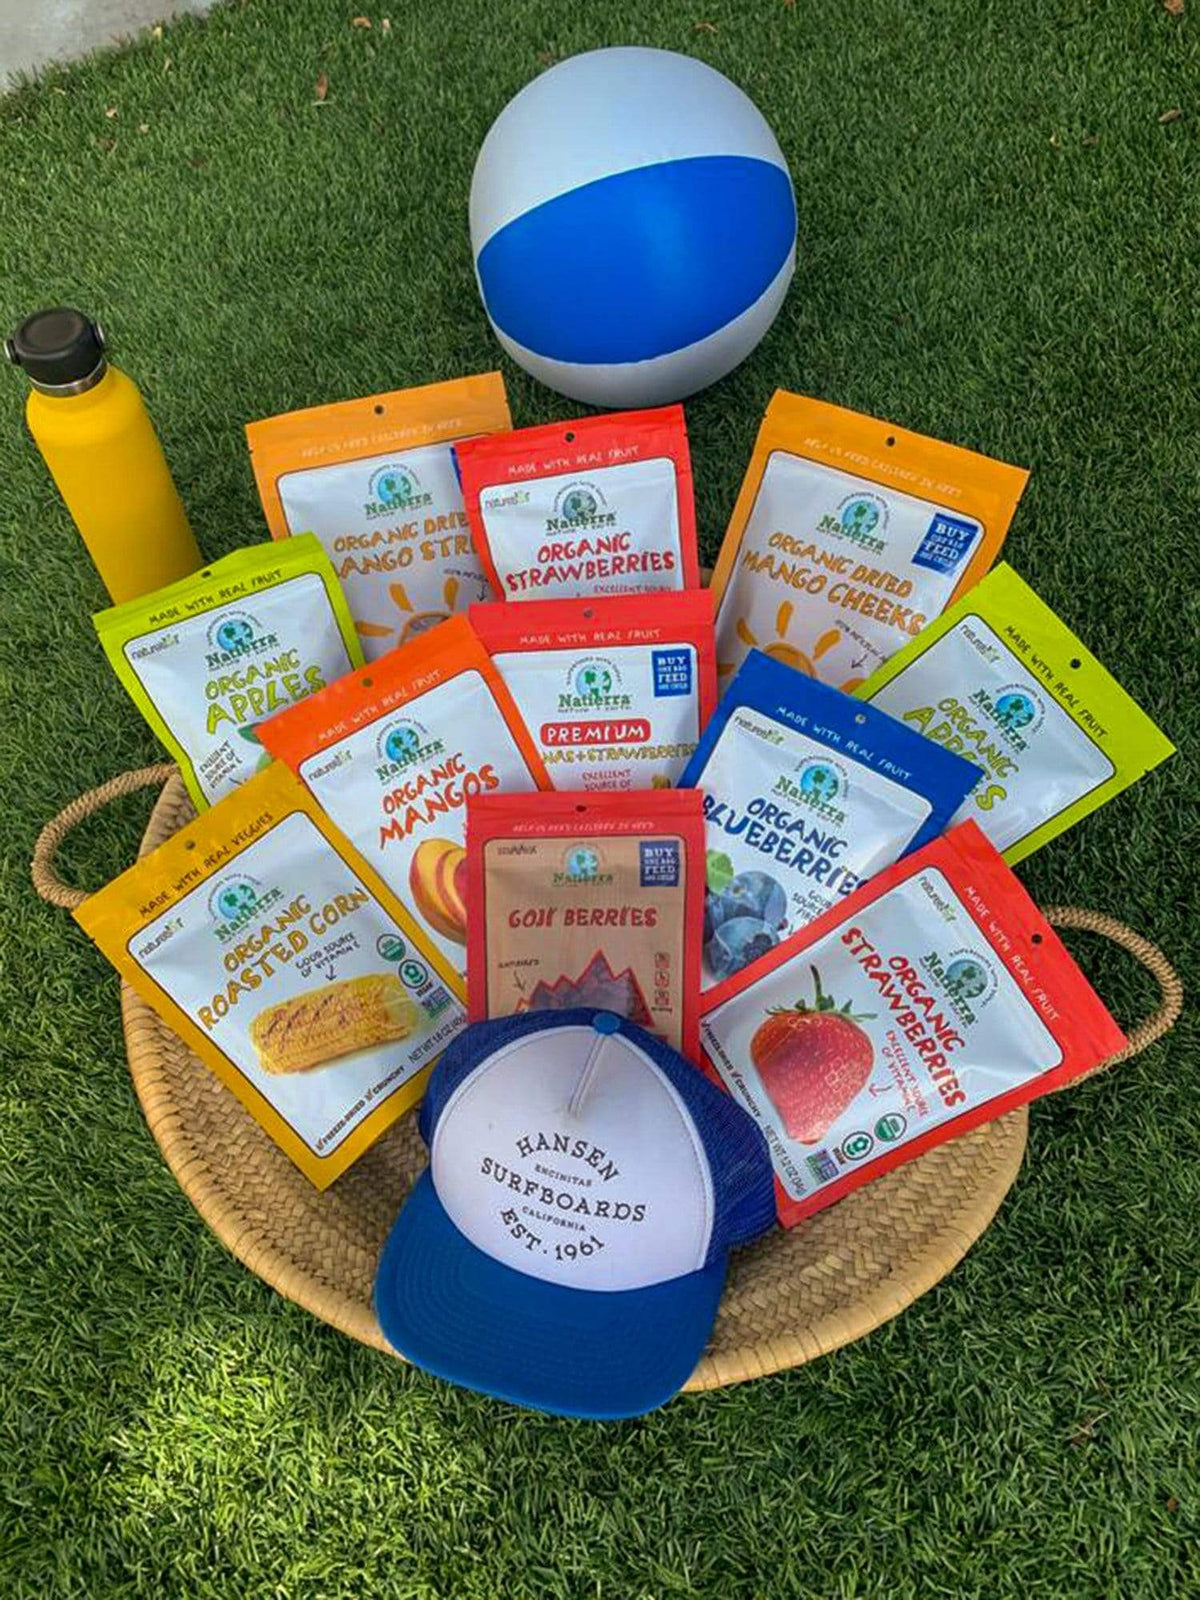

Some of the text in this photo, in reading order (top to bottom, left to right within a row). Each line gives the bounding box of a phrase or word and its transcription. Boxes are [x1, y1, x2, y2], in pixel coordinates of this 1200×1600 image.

[508, 445, 640, 476] MADE WITH REAL FRUIT
[333, 521, 418, 552] ORGANIC
[424, 512, 470, 535] DRIE
[537, 532, 632, 564] ORGANIC
[925, 540, 960, 560] FEED
[935, 523, 970, 541] BUY
[340, 546, 413, 579] ANGO
[505, 551, 676, 593] STRAWBERRIES
[768, 532, 854, 575] ORGANIC
[852, 564, 914, 599] DRIED
[149, 569, 283, 625] MADE WITH REAL FRUIT
[742, 550, 927, 636] MANGO CHEEKS
[520, 629, 661, 645] MADE WITH REAL FRUIT
[657, 656, 686, 666] BUY
[205, 649, 298, 700] ORGANIC
[657, 674, 688, 684] FEED
[1005, 625, 1031, 655] MADE
[1031, 652, 1054, 683] WITH
[1054, 681, 1078, 708] REAL
[1077, 707, 1108, 738] FRUIT
[206, 665, 328, 735] APPLES
[319, 669, 440, 740] MADE WITH REAL FRUIT
[558, 694, 631, 708] Natierra
[547, 724, 645, 743] PREMIUM
[776, 705, 912, 781] MADE WITH REAL FRUIT
[903, 706, 1007, 811] APPS
[937, 697, 1019, 779] ORGANIC
[380, 764, 499, 850] MANGOS
[383, 753, 465, 814] ORGANIC
[644, 848, 674, 858] BUY
[747, 798, 848, 858] ORGANIC
[140, 811, 274, 918] MADE WITH REAL VEGGIES
[644, 866, 676, 875] FEED
[222, 894, 311, 973] ORGANIC
[508, 907, 657, 928] GOJI BERRIES
[197, 930, 309, 1030] ROASTED
[309, 886, 370, 937] CORN
[295, 931, 355, 969] GOOD SOURCE
[965, 886, 1059, 1022] MADE WITH REAL FRUIT
[841, 927, 967, 1107] STRAWBERRIES
[889, 956, 966, 1051] ORGANIC
[516, 1132, 620, 1182] HANSEN
[535, 1164, 593, 1187] ENCINITAS
[480, 1157, 646, 1222] SURFBOARDS
[522, 1206, 587, 1231] CALIFORNIA
[555, 1235, 605, 1261] 1961
